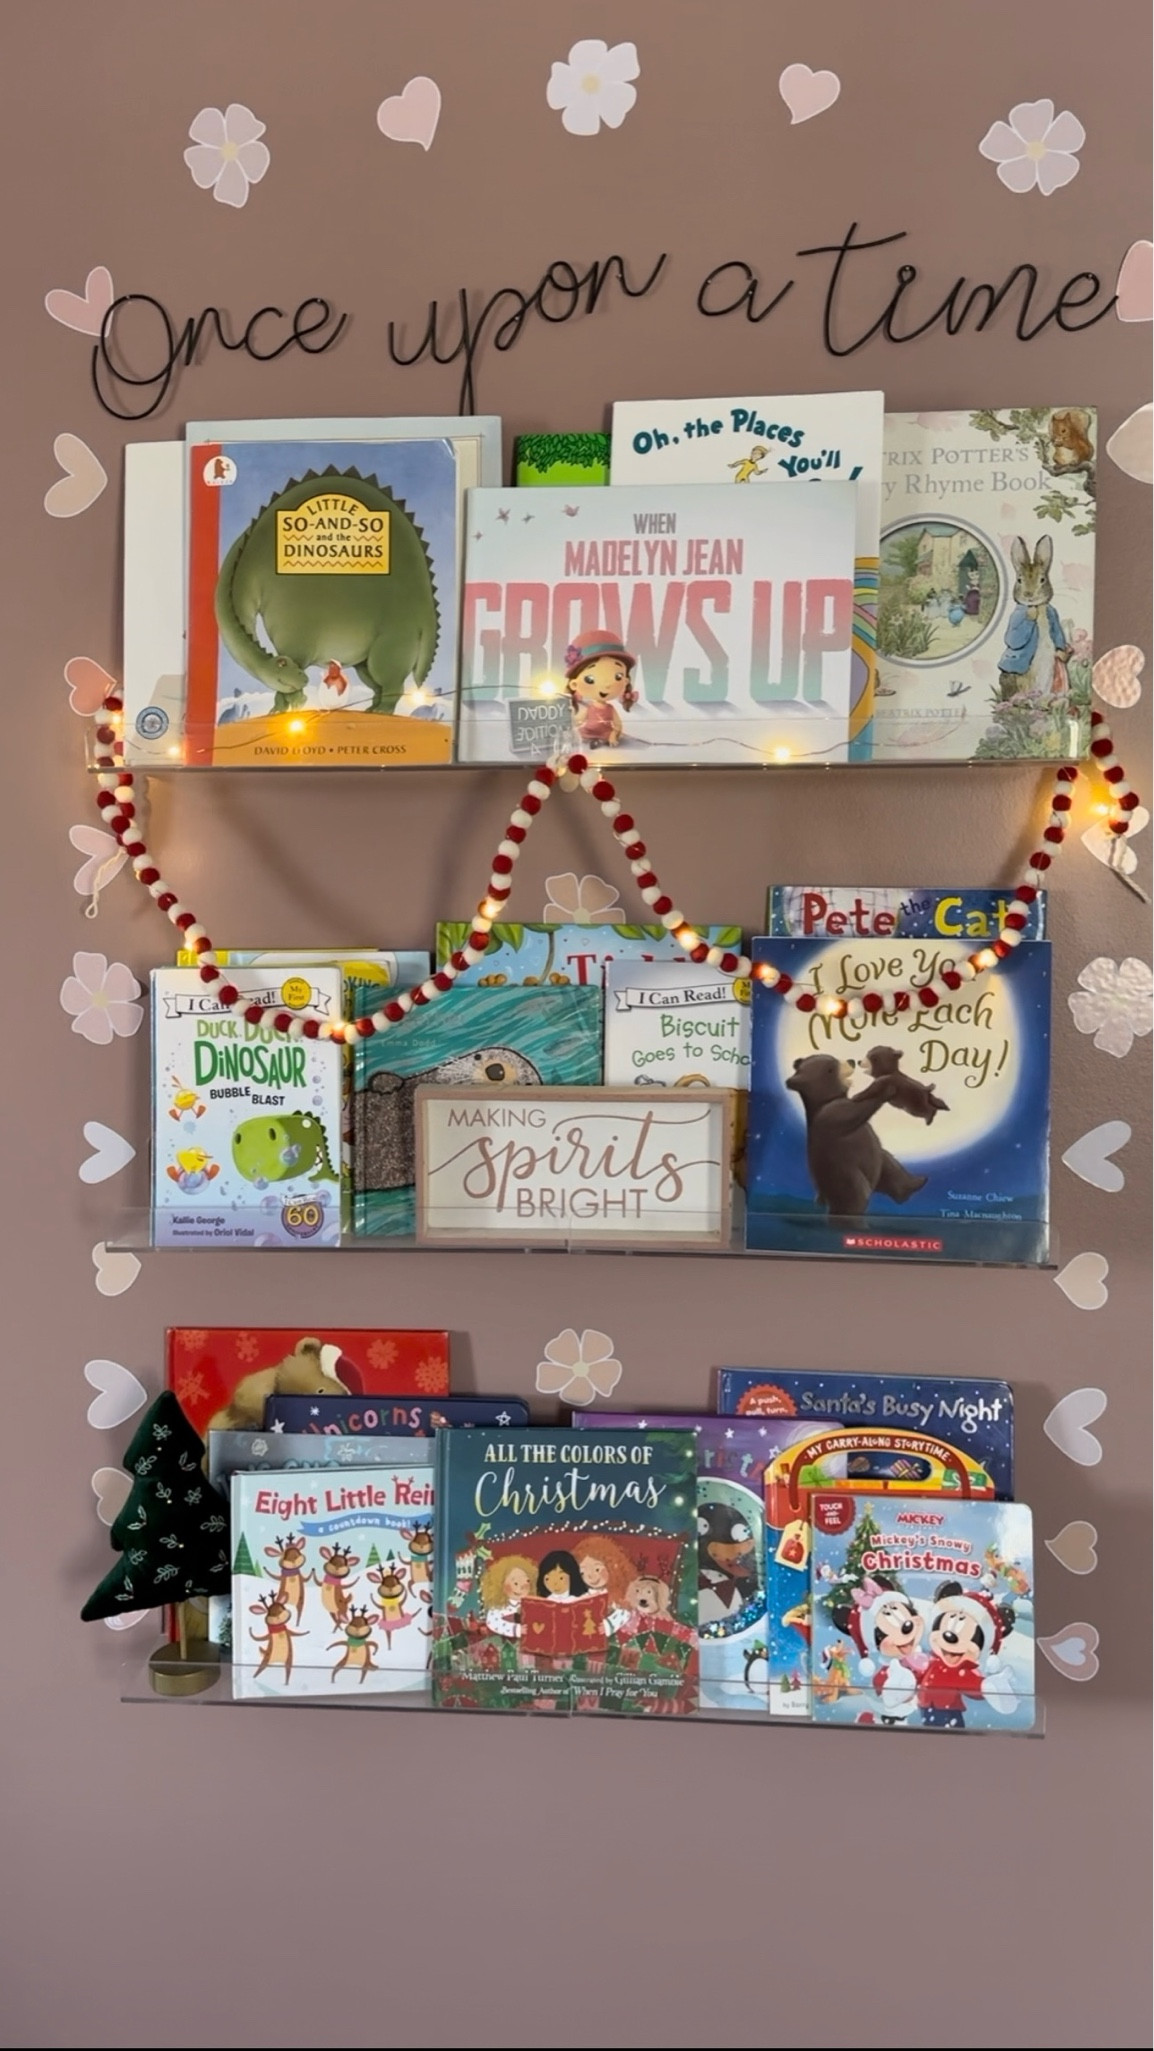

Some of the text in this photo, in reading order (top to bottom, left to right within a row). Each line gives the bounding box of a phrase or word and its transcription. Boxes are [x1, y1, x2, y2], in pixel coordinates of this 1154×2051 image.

[92, 294, 349, 420] Once
[387, 253, 667, 417] upon
[697, 261, 795, 323] a
[633, 408, 805, 454] Oh, the Places
[778, 450, 840, 477] You'll
[883, 447, 1029, 465] RIX POTTER'S
[906, 474, 984, 498] Rhyme
[992, 471, 1052, 492] Book
[307, 498, 359, 516] LITTLE
[283, 517, 384, 532] SO-AND-SO
[633, 513, 677, 534] WHEN
[316, 533, 351, 541] and the
[283, 544, 384, 558] DINOSAURS
[564, 539, 743, 576] MADELYN JEAN
[464, 579, 853, 702] GROWS UP
[254, 746, 289, 755] DAVID
[336, 745, 370, 755] PETER
[372, 744, 407, 755] CROSS
[802, 892, 1009, 937] Pete the Cat
[808, 948, 956, 996] I Love Yo
[188, 998, 194, 1010] I
[639, 992, 645, 1004] I
[649, 992, 680, 1005] Can
[683, 987, 726, 1002] Read!
[660, 1013, 740, 1038] Biscuit
[632, 1047, 675, 1067] Goes
[683, 1042, 703, 1058] to
[919, 1039, 1009, 1088] Day!
[209, 1087, 251, 1099] BUBBLE
[252, 1094, 285, 1106] BLAST
[448, 1108, 546, 1127] MAKING
[428, 1109, 721, 1212] spirits
[516, 1187, 648, 1218] BRIGHT
[947, 1190, 982, 1201] Suzanne
[172, 1216, 225, 1226] Kallie George
[286, 1207, 319, 1226] 60
[940, 1209, 960, 1217] Tina
[214, 1228, 233, 1236] Oriol
[234, 1228, 254, 1236] Vidal
[857, 1238, 941, 1249] SCHOLASTIC
[801, 1392, 1004, 1433] Santa's Busy Night
[484, 1444, 653, 1464] ALL THE COLORS OF
[807, 1442, 822, 1458] MY
[475, 1467, 667, 1517] Christmas
[255, 1482, 435, 1521] Eight Little Rei
[819, 1502, 843, 1511] TOUCH
[328, 1517, 380, 1532] countdown
[385, 1517, 412, 1528] book!
[824, 1517, 841, 1525] FEEL
[897, 1513, 944, 1525] MICKEY
[871, 1535, 971, 1553] Mickey's Snowy
[862, 1551, 980, 1576] Christmas
[507, 1669, 529, 1682] Paul
[531, 1670, 564, 1683] Turner
[605, 1687, 624, 1699] Pray
[625, 1687, 638, 1697] for
[640, 1688, 658, 1698] You
